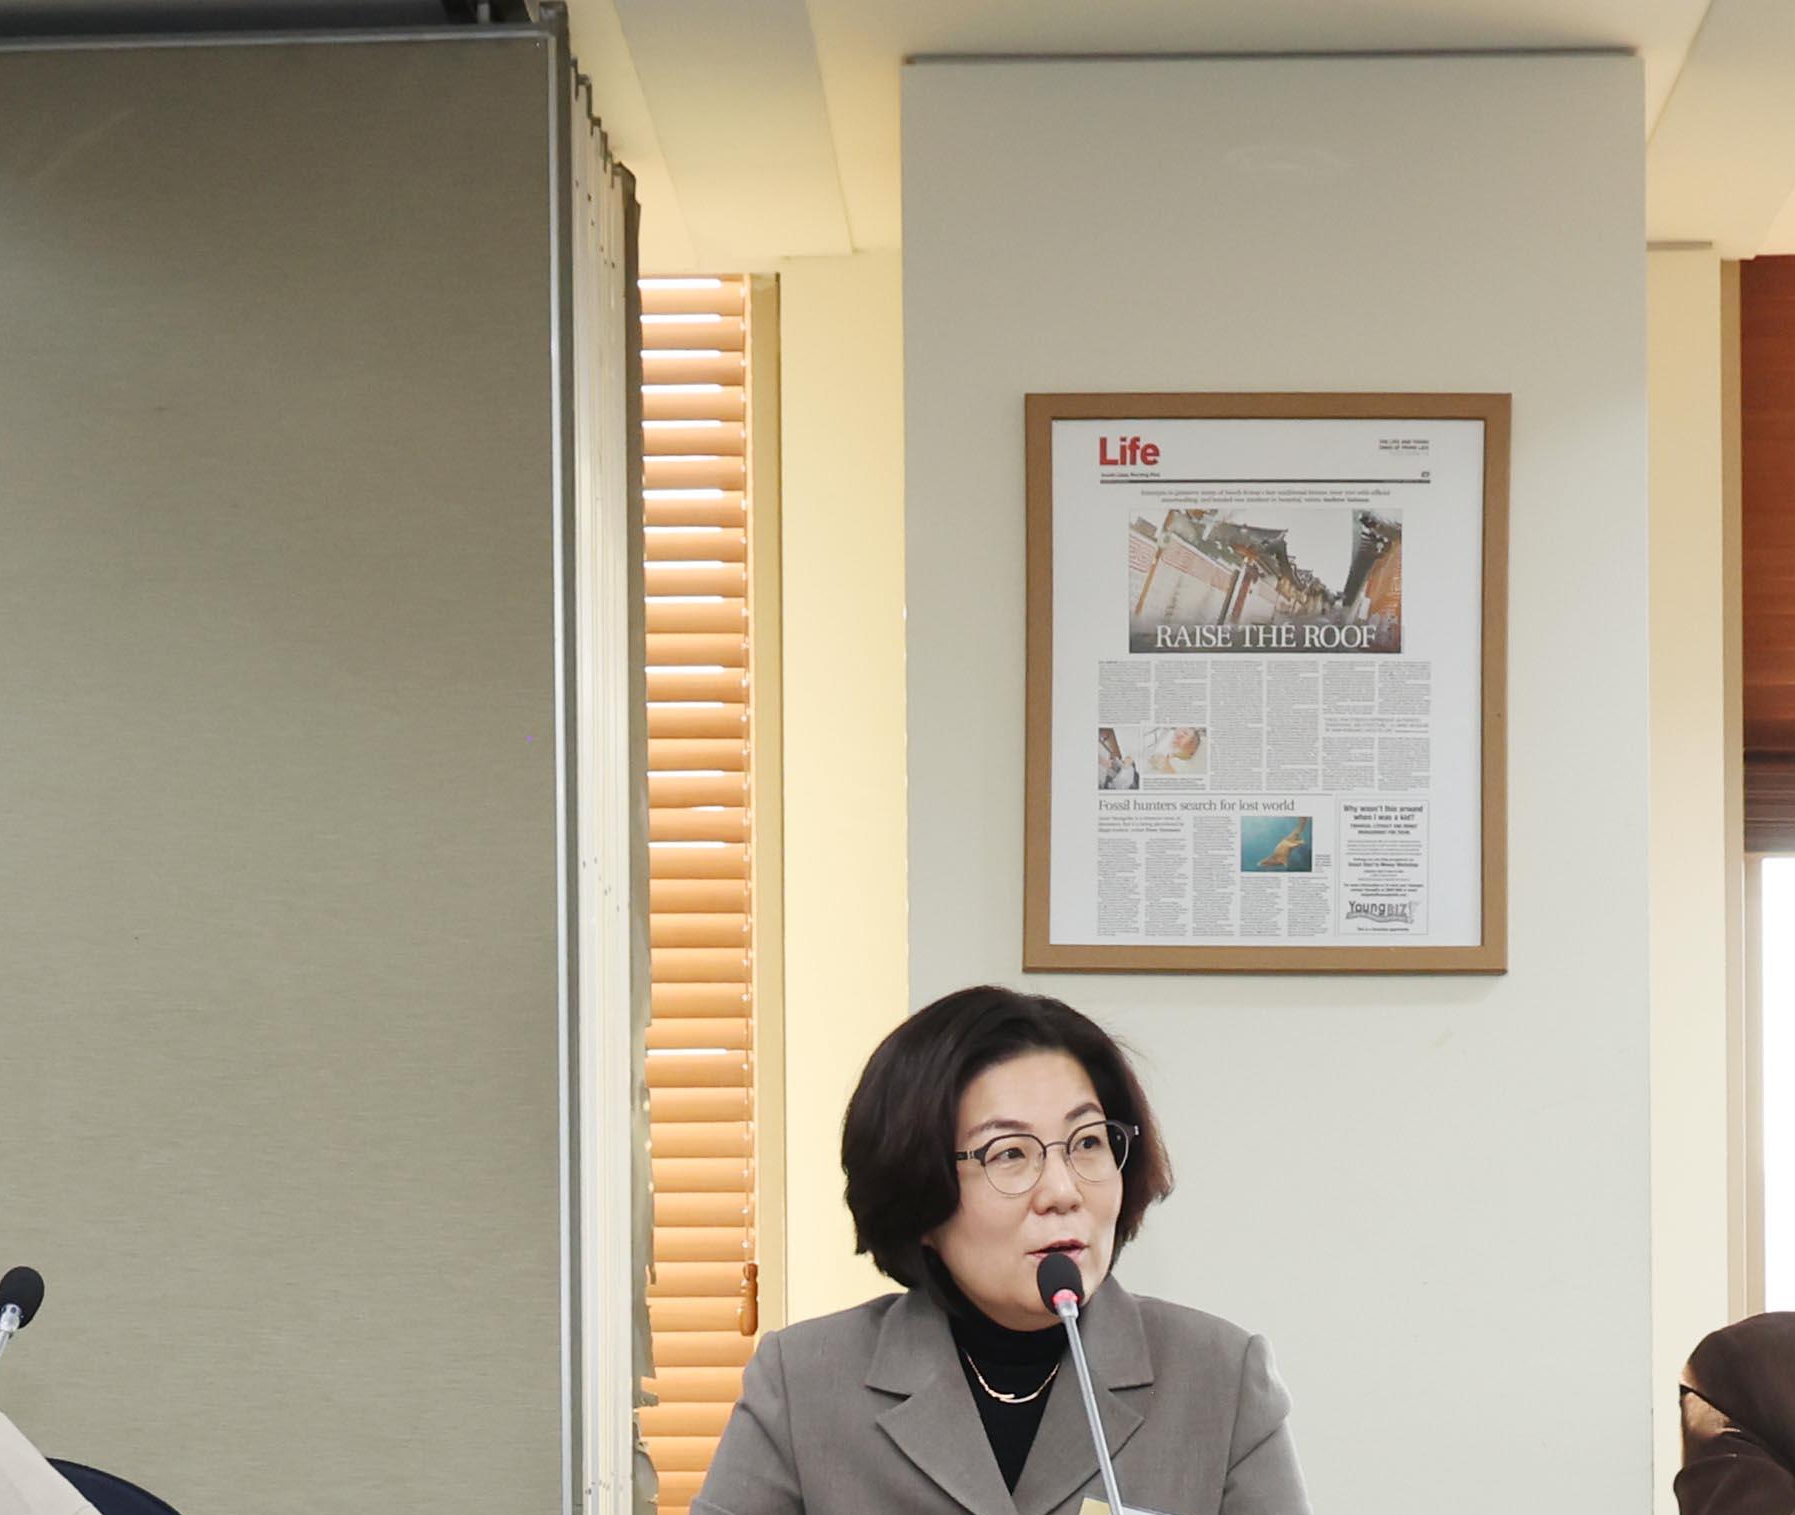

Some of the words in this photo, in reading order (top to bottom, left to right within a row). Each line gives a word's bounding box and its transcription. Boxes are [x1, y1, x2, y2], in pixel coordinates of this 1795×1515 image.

[1099, 437, 1161, 466] Life
[1156, 624, 1233, 648] RAISE
[1238, 624, 1296, 648] THE
[1303, 624, 1378, 648] ROOF
[1098, 799, 1131, 811] Fossil
[1133, 799, 1177, 811] hunters
[1179, 799, 1218, 811] search
[1220, 799, 1236, 811] for
[1238, 799, 1259, 811] lost
[1260, 799, 1295, 811] world
